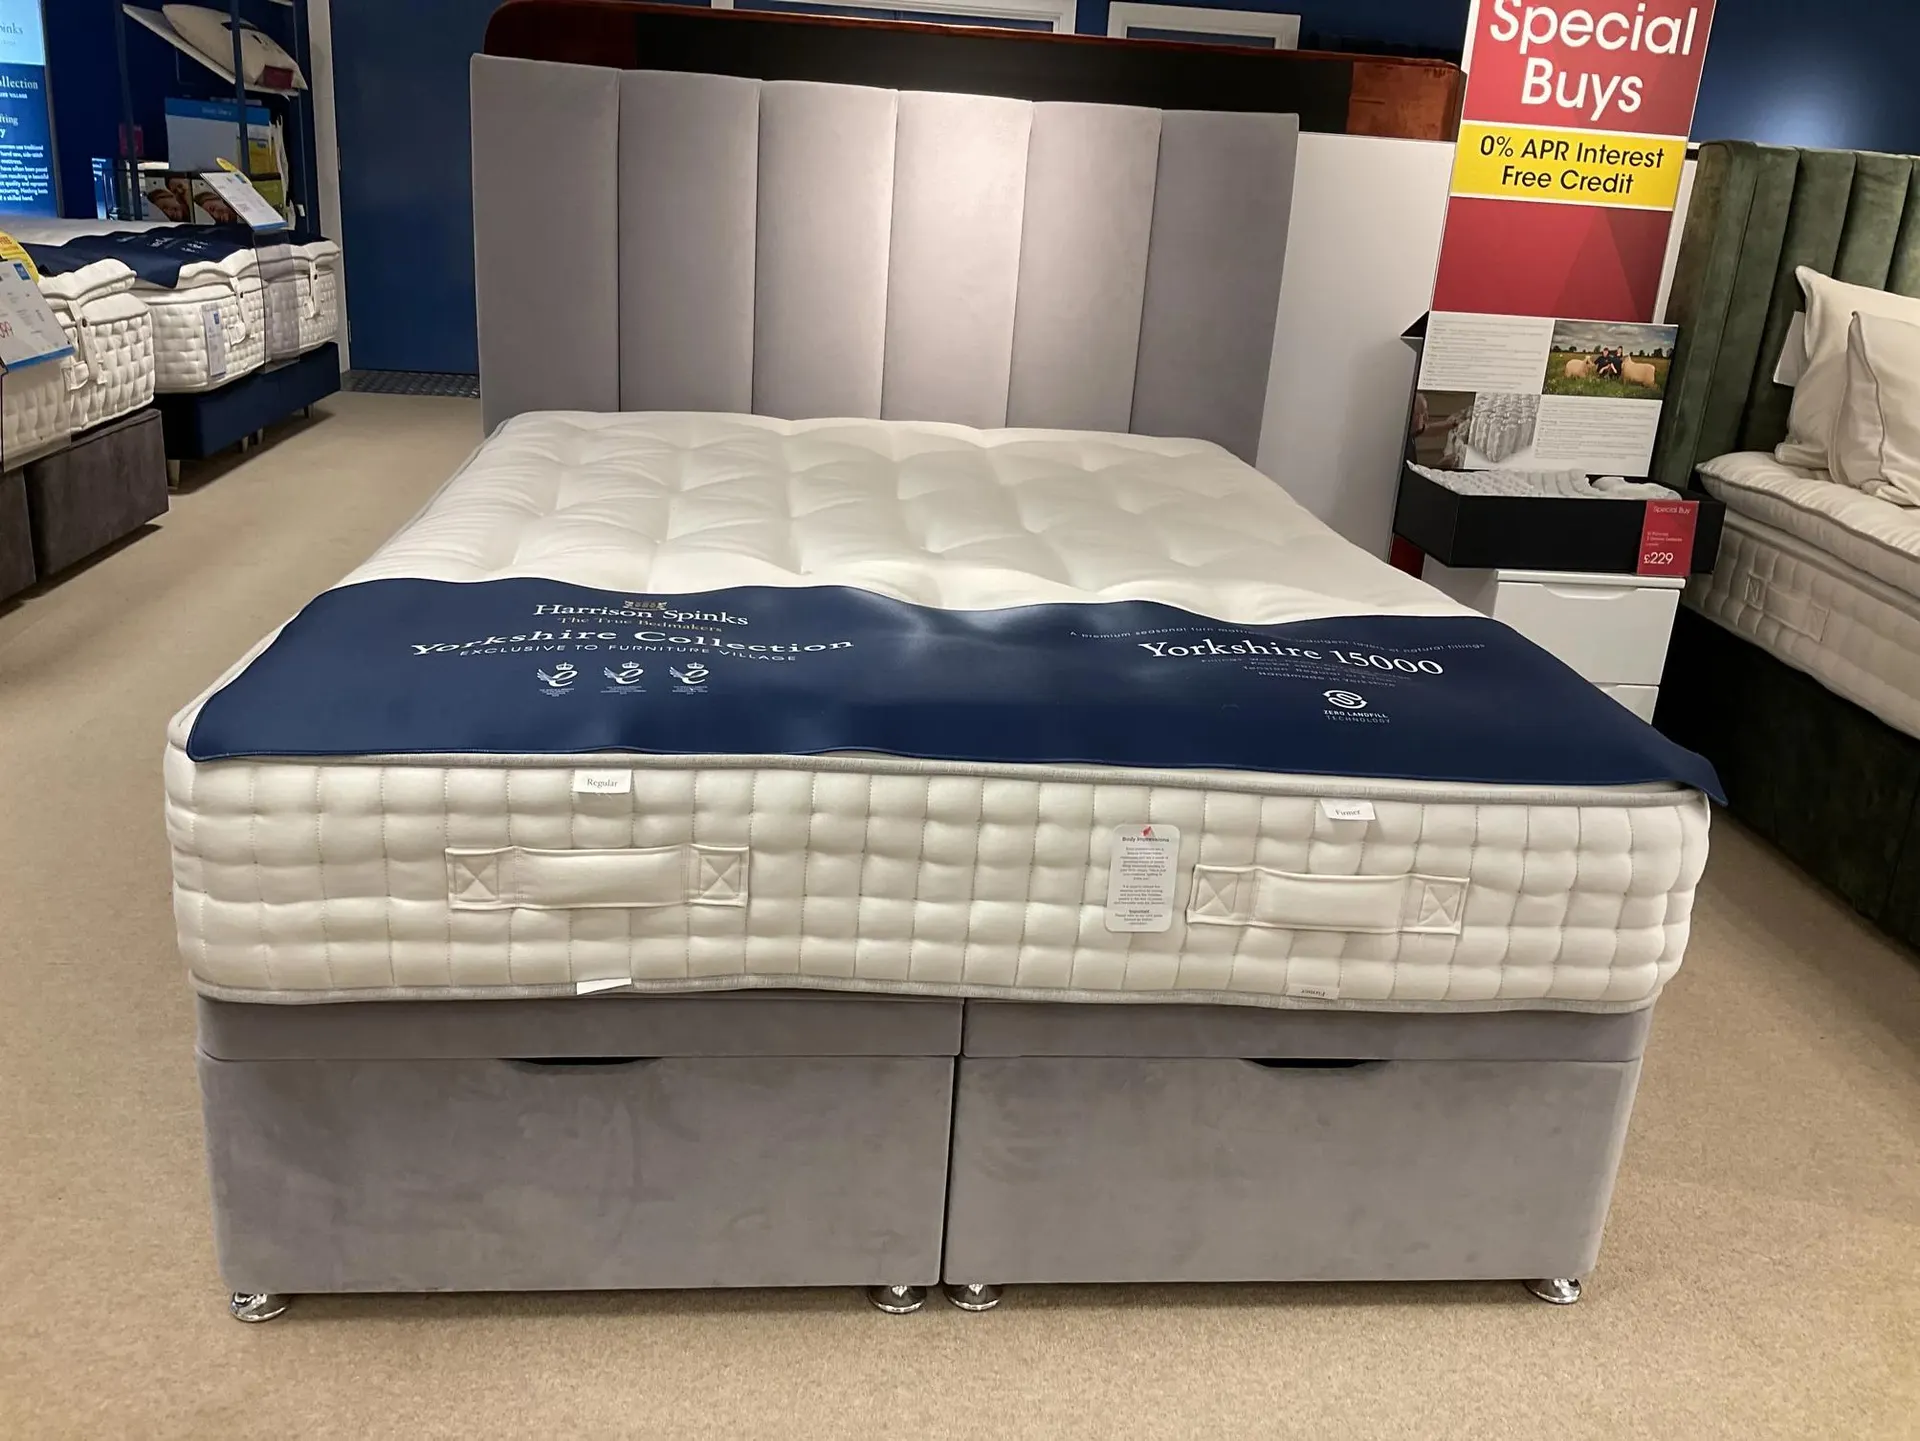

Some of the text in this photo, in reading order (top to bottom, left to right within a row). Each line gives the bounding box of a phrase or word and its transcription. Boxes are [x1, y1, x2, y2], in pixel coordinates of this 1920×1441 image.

[1490, 0, 1698, 56] Special
[1521, 57, 1644, 122] Buys
[1480, 135, 1665, 169] 0% APR Interest
[1502, 165, 1634, 194] Free Credit
[1653, 505, 1691, 515] Special Buy
[1643, 552, 1674, 565] £229
[532, 604, 749, 626] Harrison Spinks
[593, 617, 632, 625] True
[638, 619, 722, 633] Bedmakers
[1081, 631, 1131, 639] premium
[1135, 627, 1187, 636] seasonal
[411, 629, 855, 656] Yorkshire Collection
[459, 644, 566, 656] EXCLUSIVE
[608, 644, 710, 654] FURNITURE
[719, 650, 796, 662] VILLAGE
[1138, 638, 1444, 676] Yorkshire 15000
[1327, 715, 1390, 724] TECHNOLOGY
[1346, 711, 1389, 719] LANDFILL
[587, 778, 618, 789] Regular
